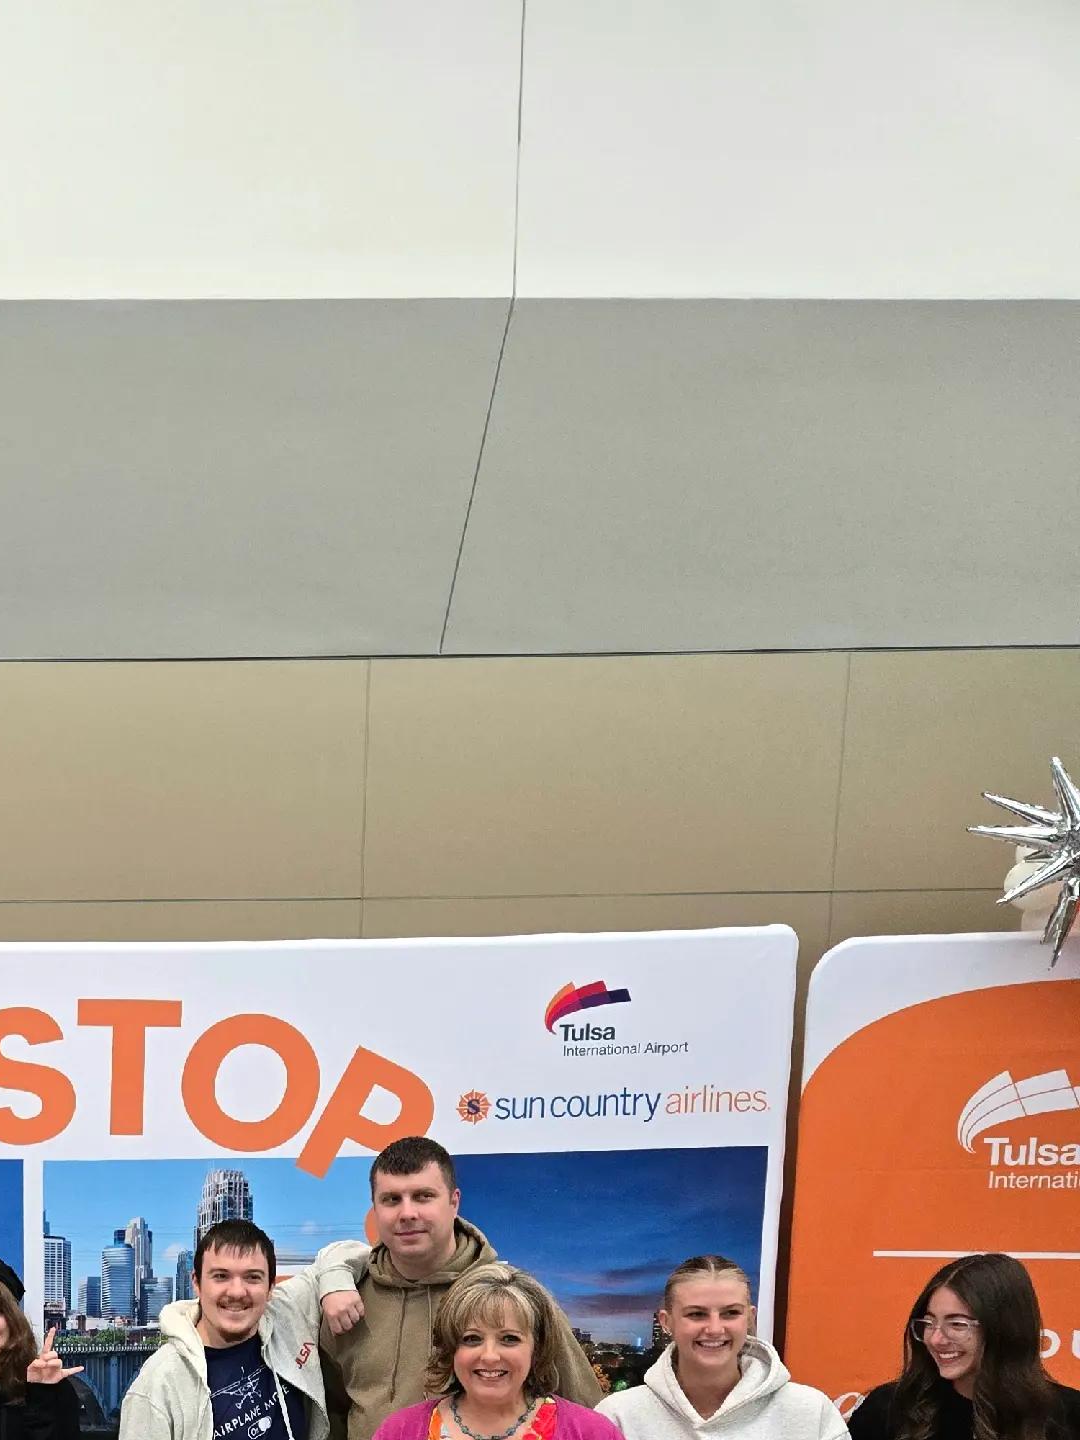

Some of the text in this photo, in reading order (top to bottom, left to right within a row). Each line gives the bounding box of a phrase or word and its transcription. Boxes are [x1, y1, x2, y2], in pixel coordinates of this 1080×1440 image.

[559, 1023, 616, 1041] Tulsa
[563, 1041, 689, 1056] International Airport
[494, 1096, 545, 1120] sun
[550, 1087, 661, 1122] country
[983, 1137, 1080, 1166] Tulsa
[988, 1170, 1080, 1189] Internati
[213, 1404, 262, 1440] AIRPLANE
